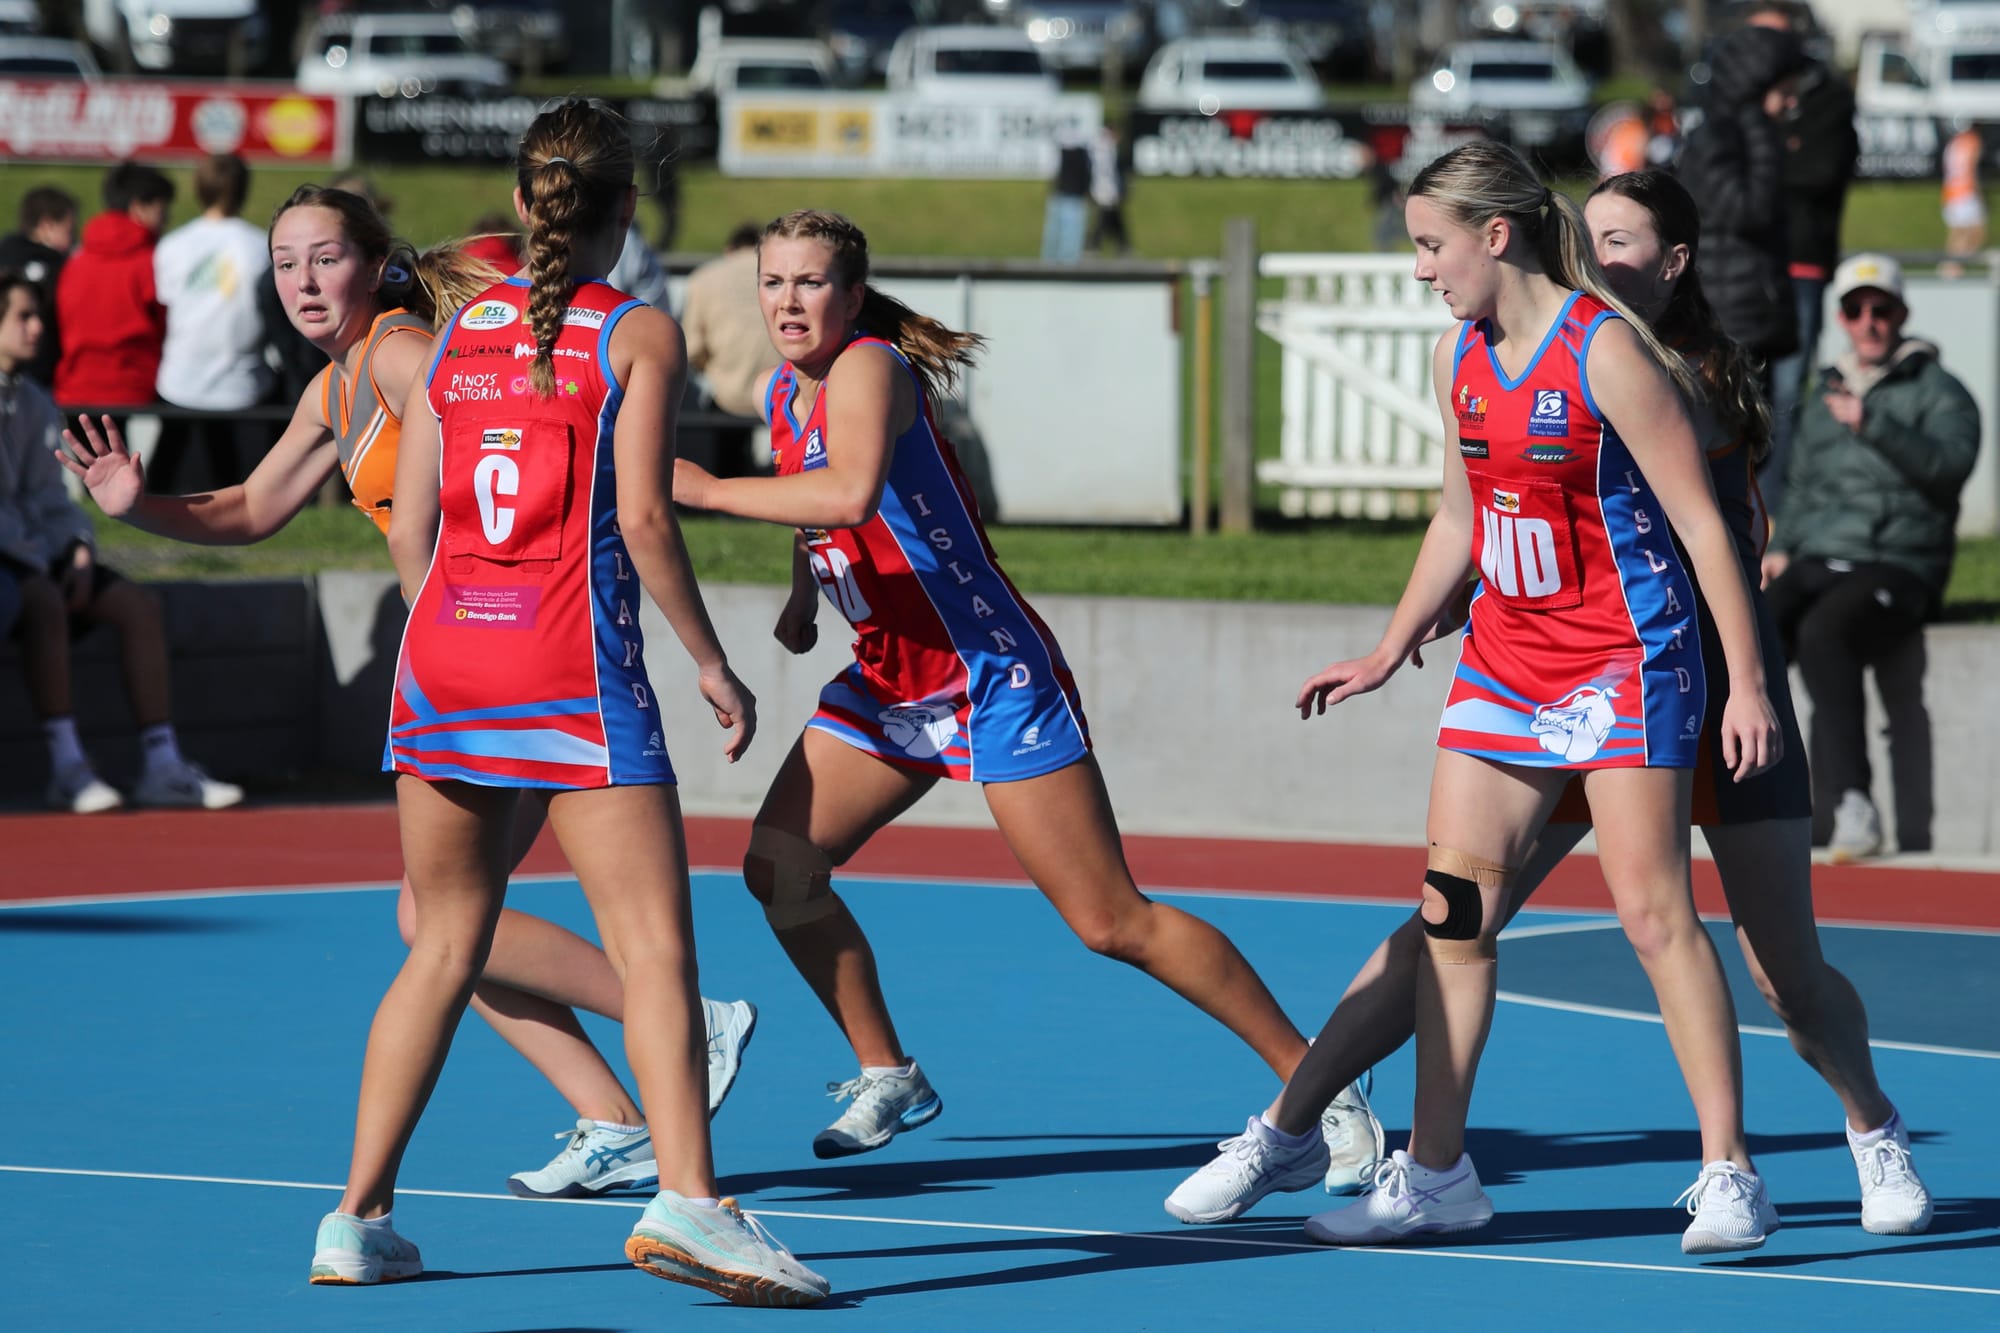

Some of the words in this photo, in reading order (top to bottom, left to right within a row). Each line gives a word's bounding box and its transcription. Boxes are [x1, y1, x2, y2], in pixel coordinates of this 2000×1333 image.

[482, 306, 508, 316] RSL
[565, 348, 591, 361] Brick
[474, 455, 519, 546] C
[1481, 505, 1561, 598] WD
[467, 611, 497, 621] Bendigo
[498, 613, 517, 621] Bank
[912, 493, 1031, 690] ISLAND
